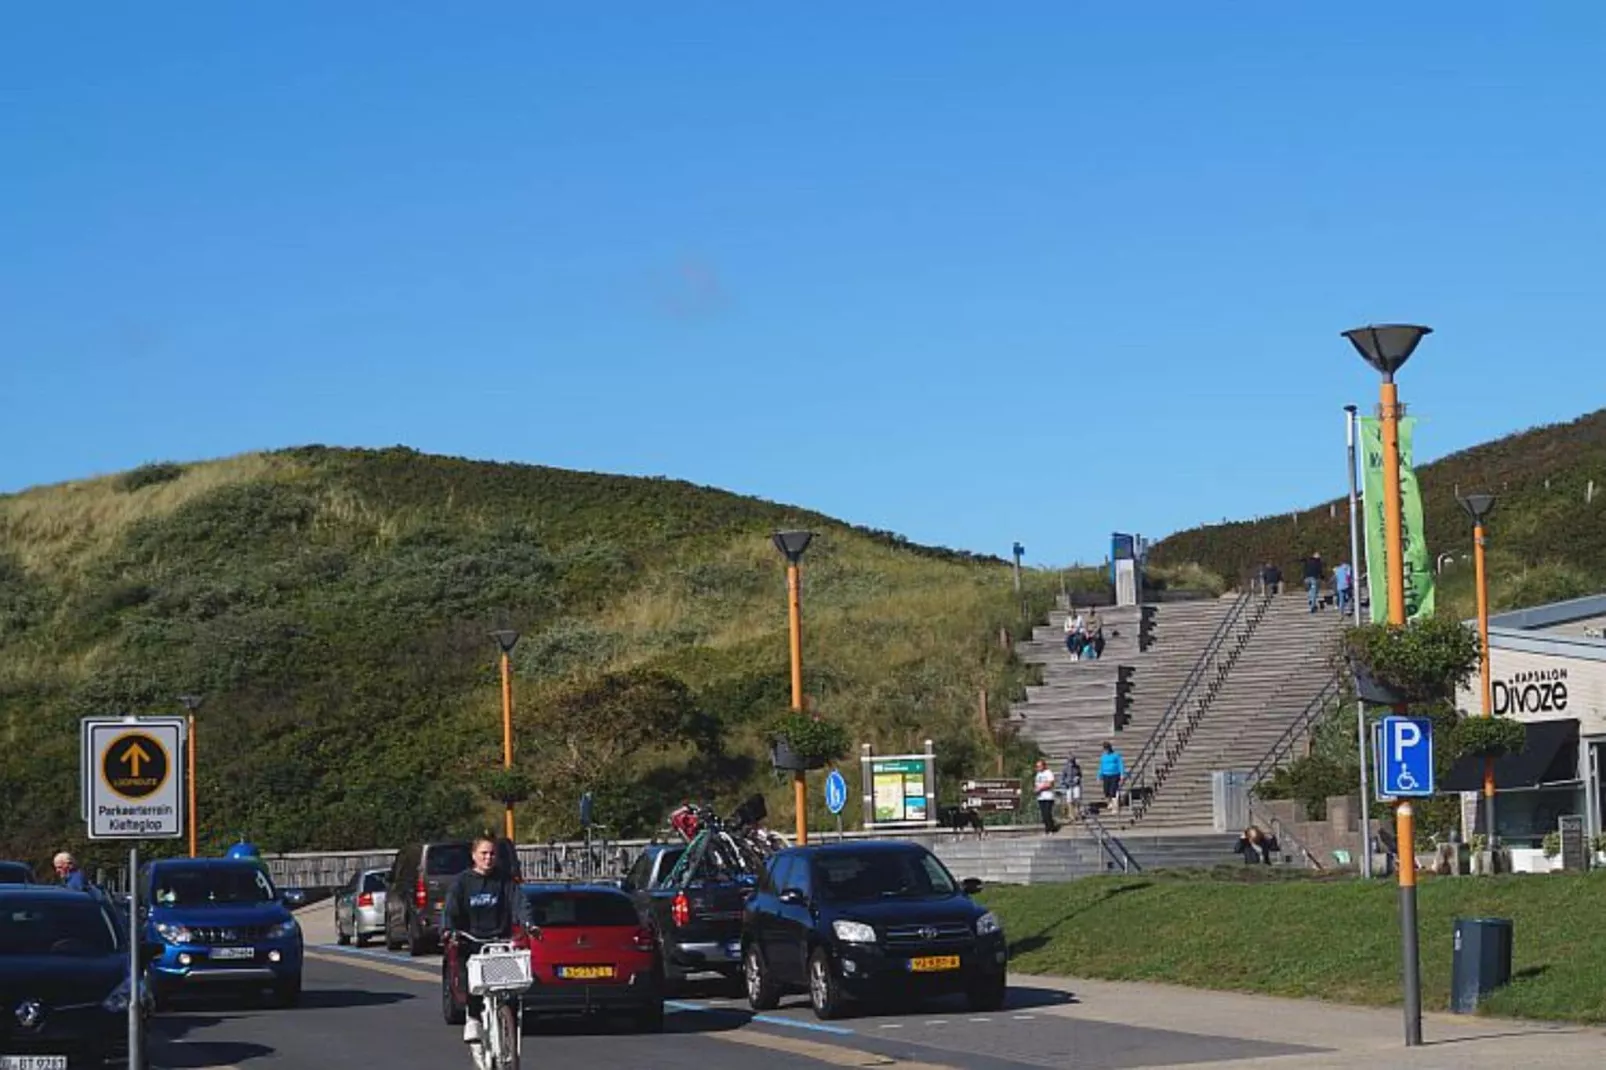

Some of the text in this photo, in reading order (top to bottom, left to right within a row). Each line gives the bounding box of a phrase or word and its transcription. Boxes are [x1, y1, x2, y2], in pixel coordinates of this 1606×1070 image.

[1515, 668, 1567, 683] KAPSALON
[1491, 679, 1568, 715] Divoze
[1394, 722, 1421, 762] P
